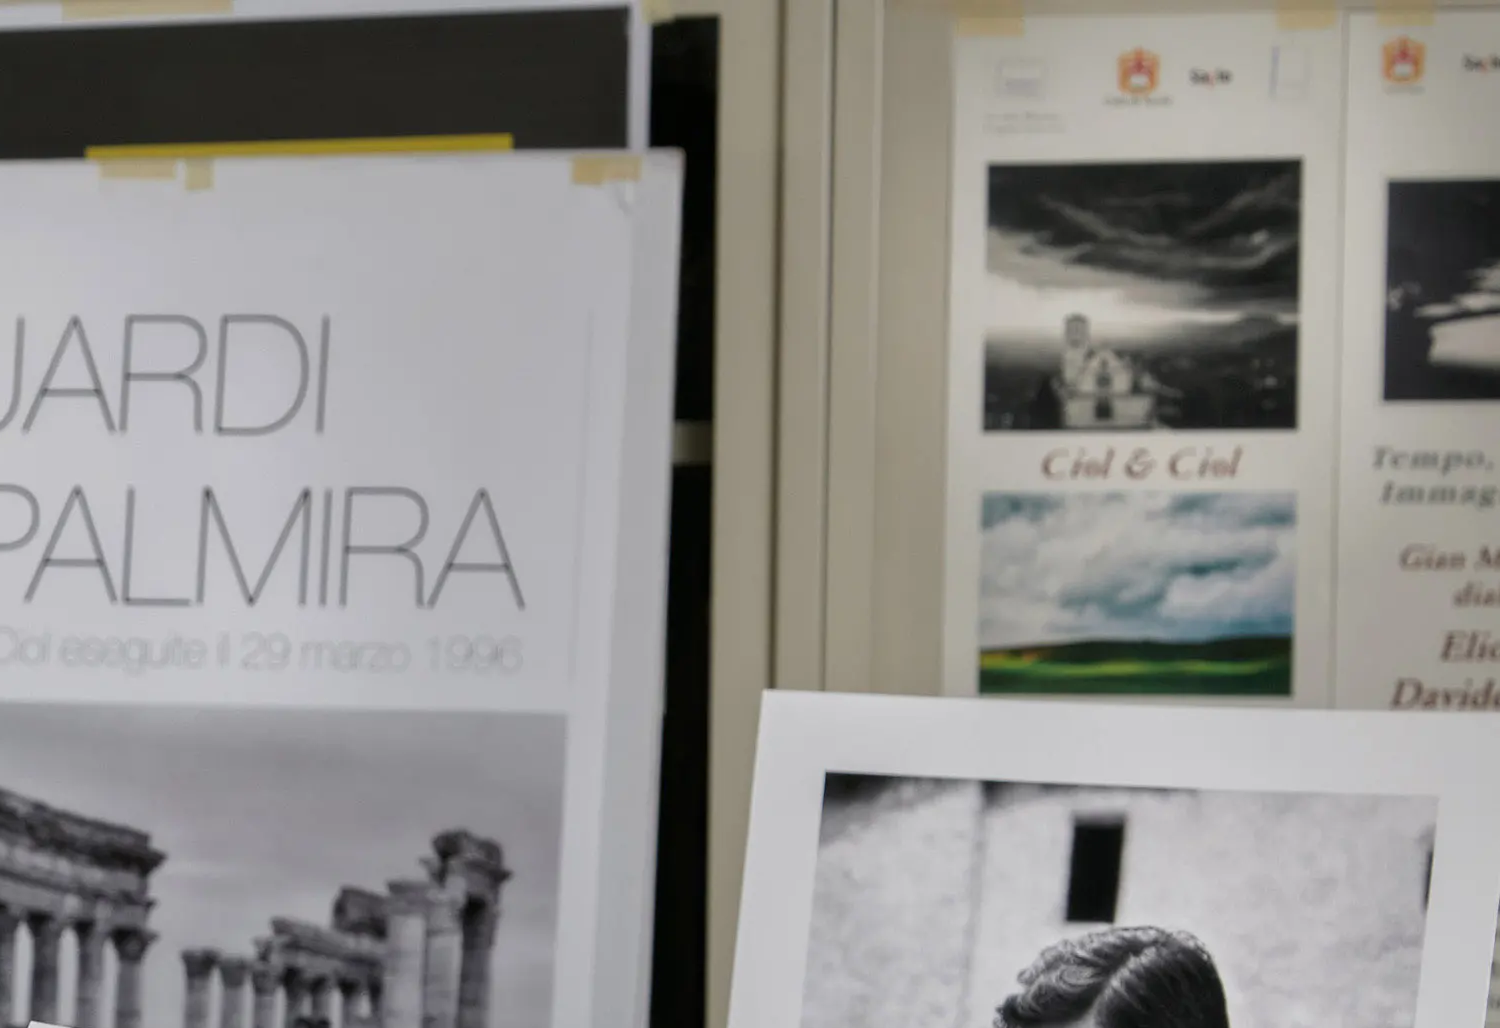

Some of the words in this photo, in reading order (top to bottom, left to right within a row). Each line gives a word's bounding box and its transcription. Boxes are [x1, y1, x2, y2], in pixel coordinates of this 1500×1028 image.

[1041, 446, 1115, 480] Ciol
[1124, 446, 1156, 480] &
[1168, 444, 1243, 480] Ciol
[1373, 445, 1495, 475] Tempo,
[240, 630, 293, 672] 29
[299, 636, 414, 674] marzo
[424, 633, 526, 675] 1996
